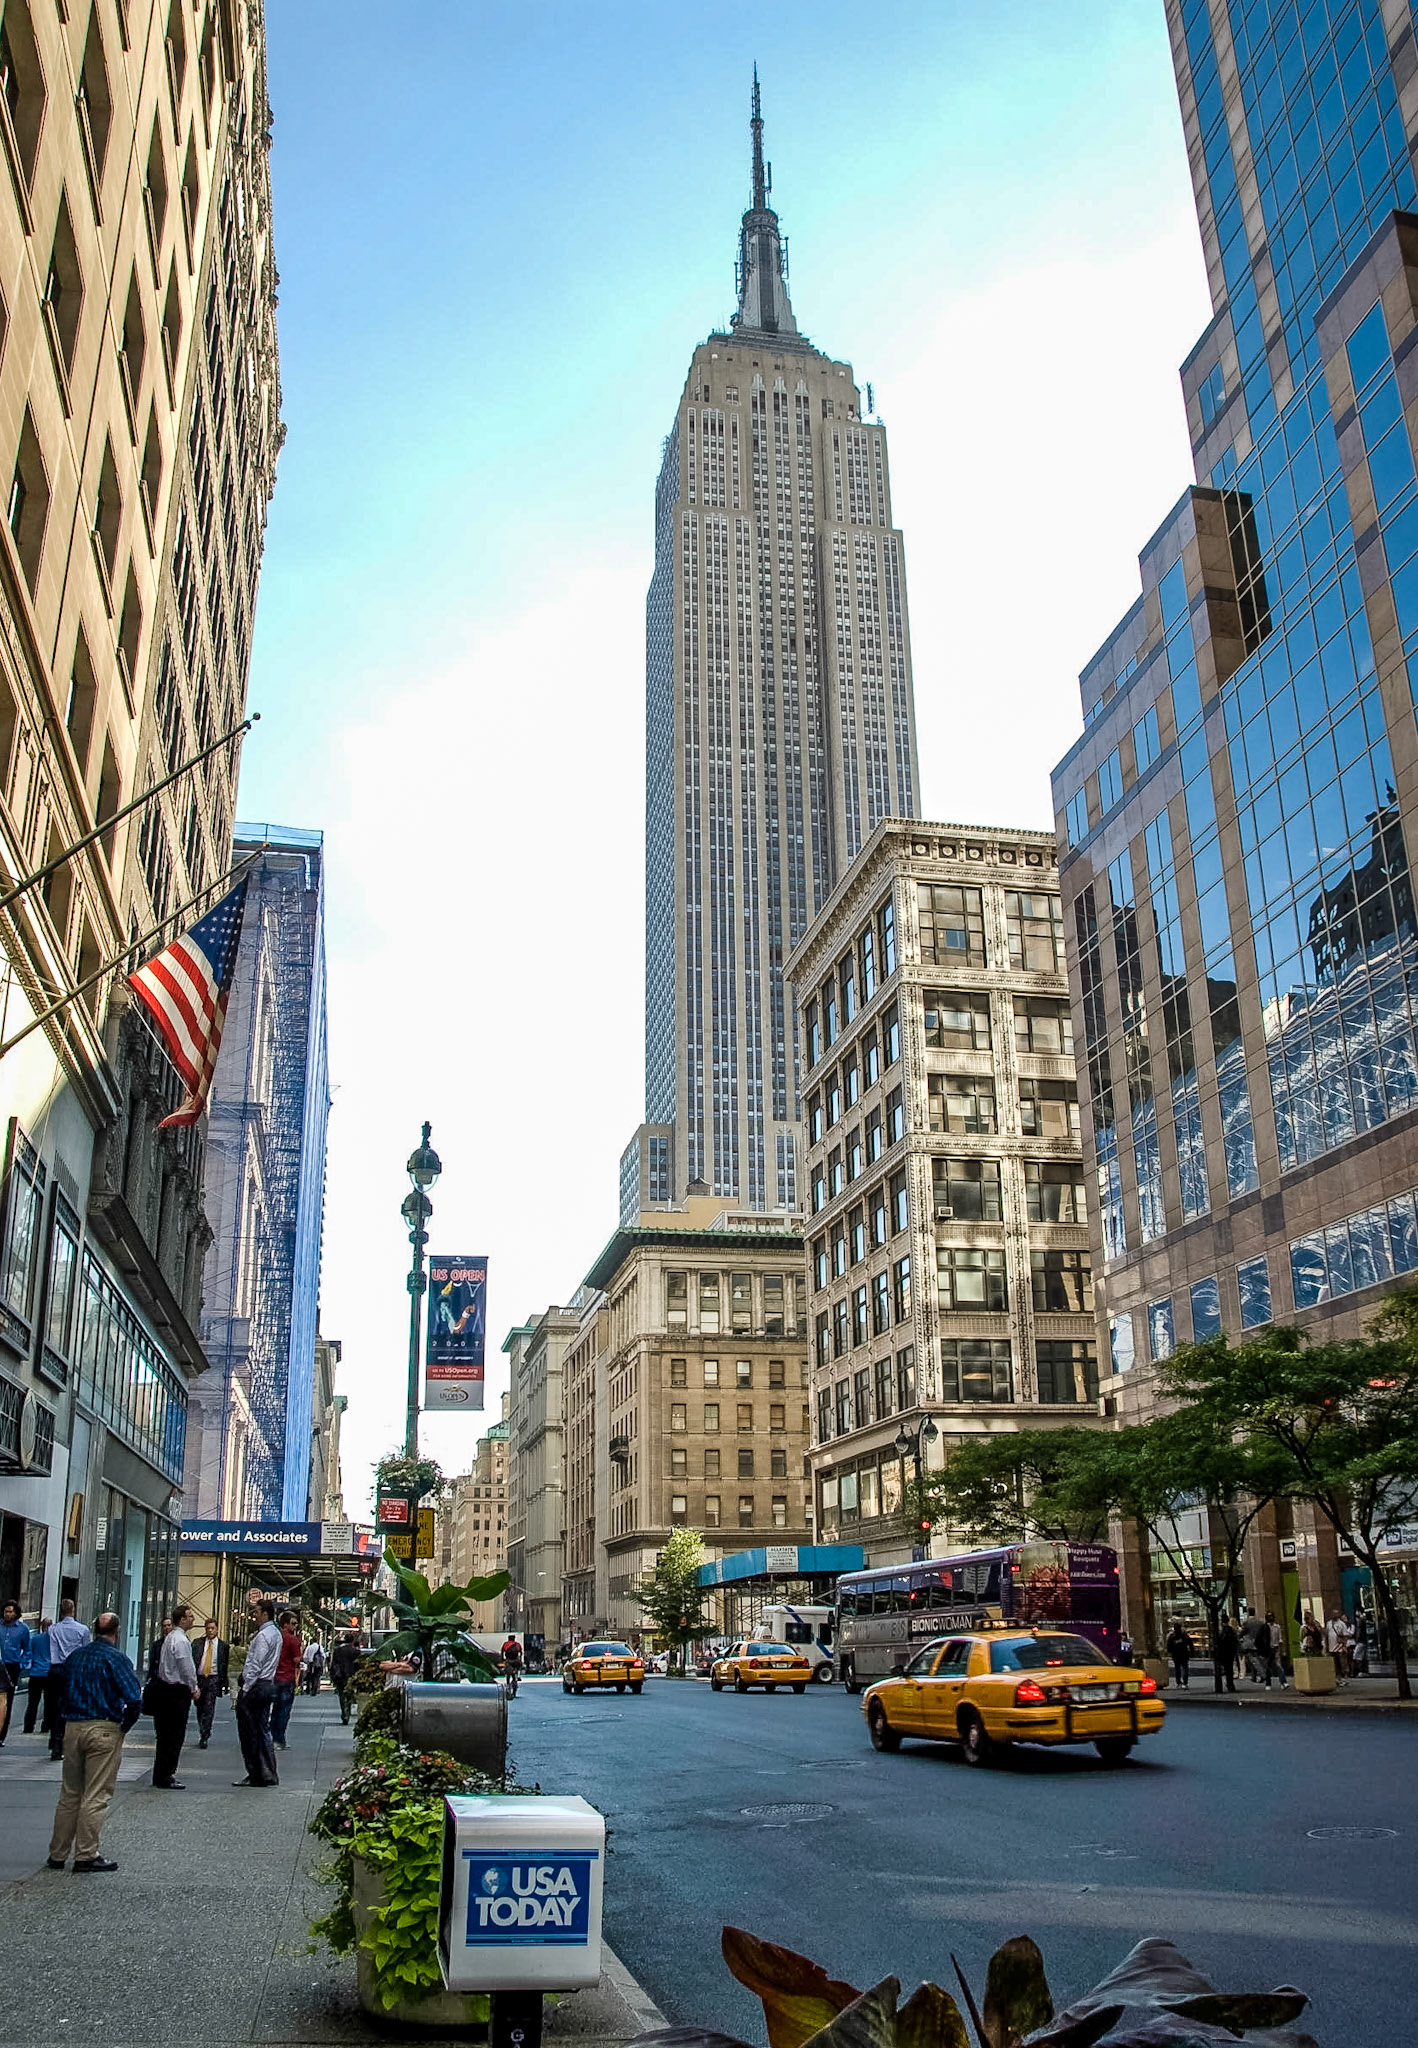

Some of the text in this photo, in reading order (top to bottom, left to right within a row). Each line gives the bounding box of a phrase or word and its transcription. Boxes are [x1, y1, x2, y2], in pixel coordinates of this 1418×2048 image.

[431, 1268, 486, 1282] US OPEN
[445, 1367, 479, 1375] USOpen.org
[216, 1529, 241, 1542] and
[243, 1530, 309, 1544] Associates
[264, 1591, 290, 1603] OPEN
[511, 1866, 578, 1896] USA
[475, 1896, 582, 1927] TODAY
